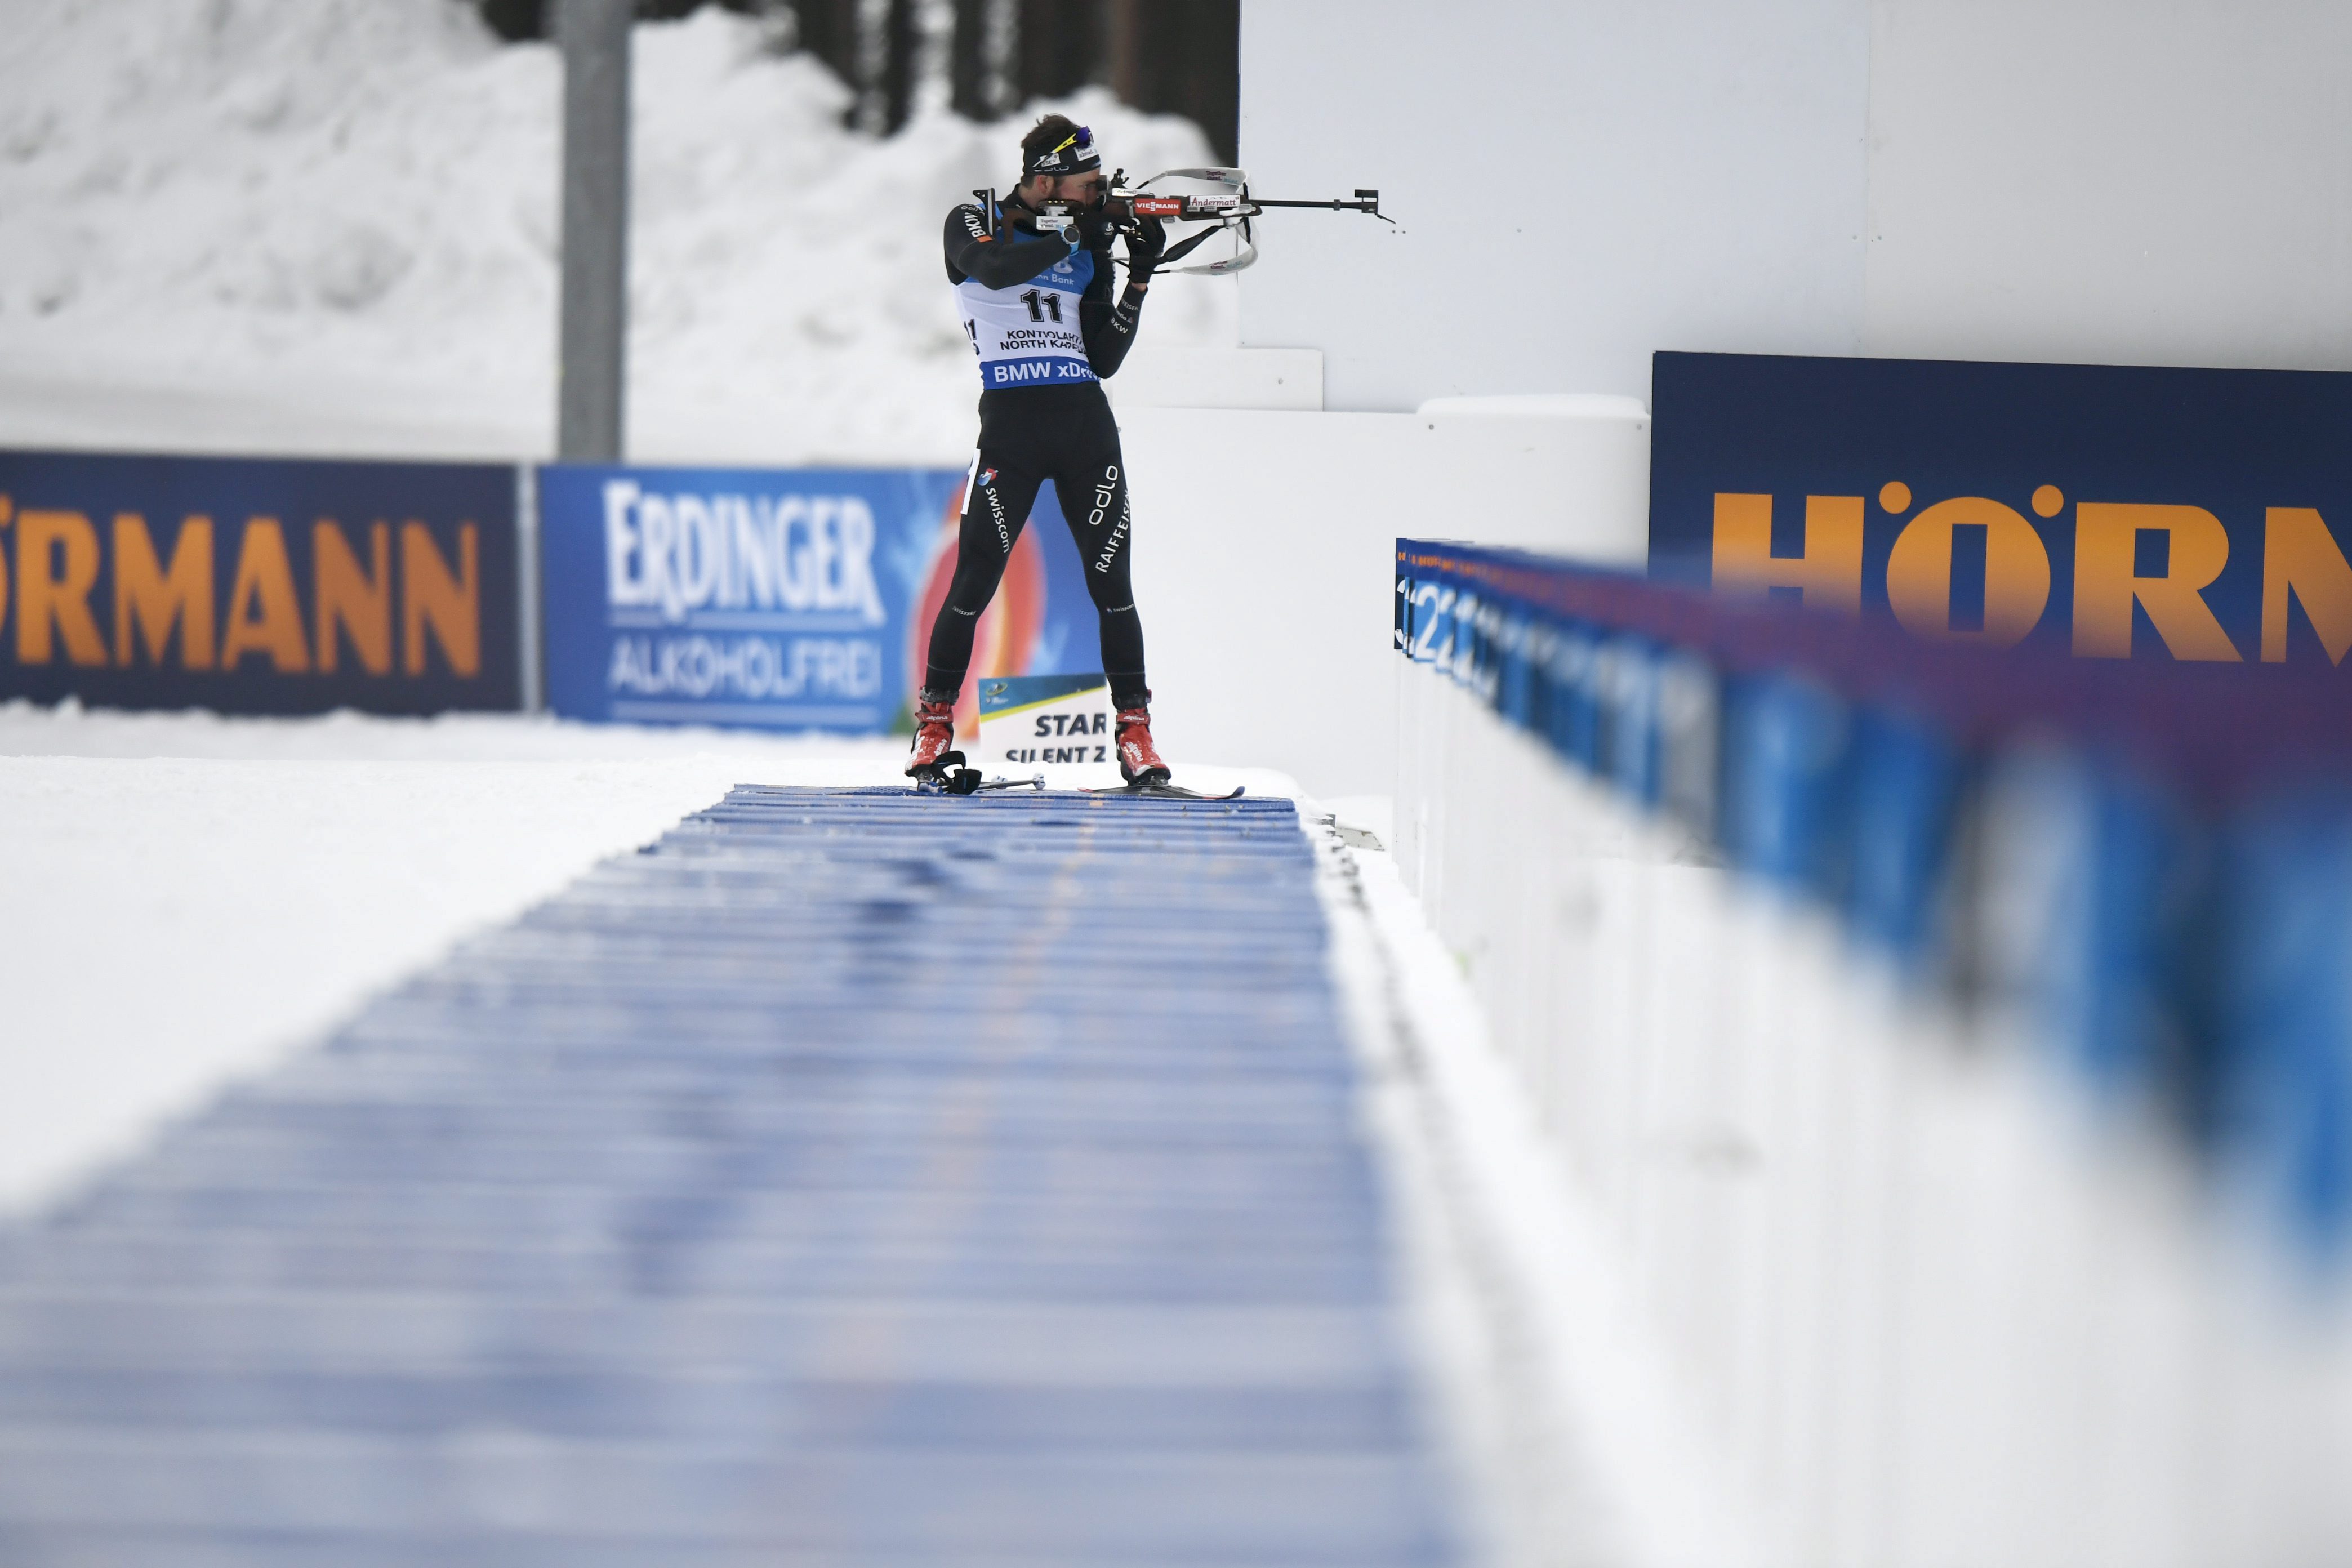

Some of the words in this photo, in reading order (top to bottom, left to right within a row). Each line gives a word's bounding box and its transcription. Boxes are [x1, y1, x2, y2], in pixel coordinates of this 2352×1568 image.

[1136, 201, 1179, 211] VIESSMANN
[1191, 197, 1236, 206] Andermatt
[964, 212, 986, 237] BKW
[1052, 274, 1075, 286] Bank
[1020, 289, 1063, 324] 11
[1111, 317, 1128, 334] BKW
[1000, 340, 1046, 350] NORTH
[994, 362, 1050, 382] BMW
[1089, 465, 1119, 525] odlo
[986, 488, 1010, 553] swisscom
[604, 479, 885, 623] ERDINGER
[0, 493, 482, 677] RMANN
[608, 634, 883, 697] ALKOHOLFREI
[1006, 746, 1089, 763] SILENT
